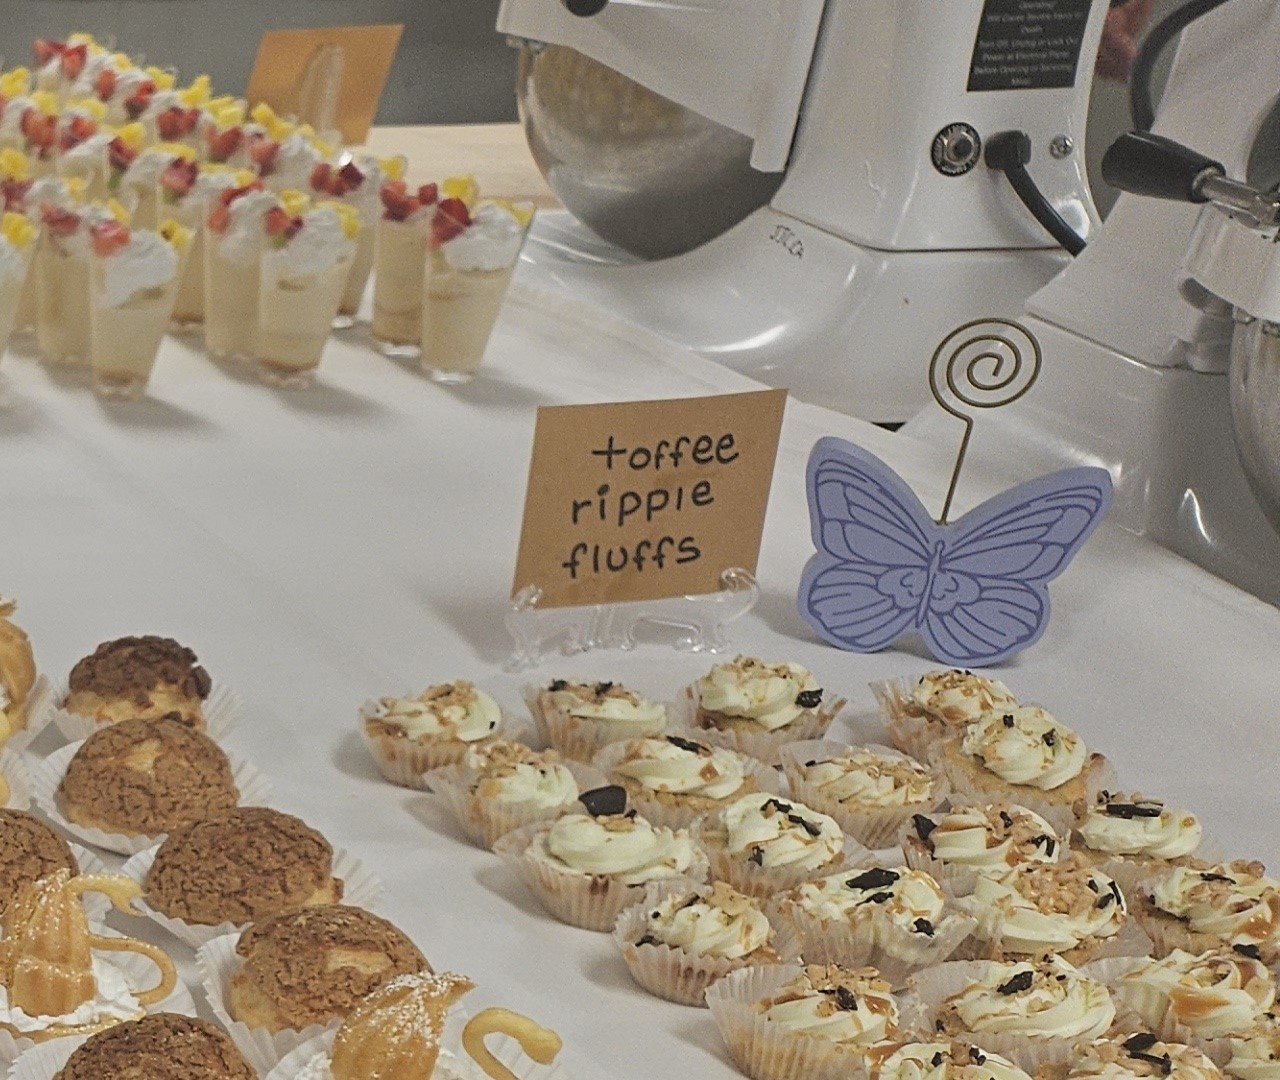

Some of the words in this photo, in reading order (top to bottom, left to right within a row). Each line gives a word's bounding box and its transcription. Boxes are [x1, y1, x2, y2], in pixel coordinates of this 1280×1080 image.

[591, 433, 739, 470] toffee
[571, 480, 714, 527] ripple
[562, 536, 701, 579] fluffs
